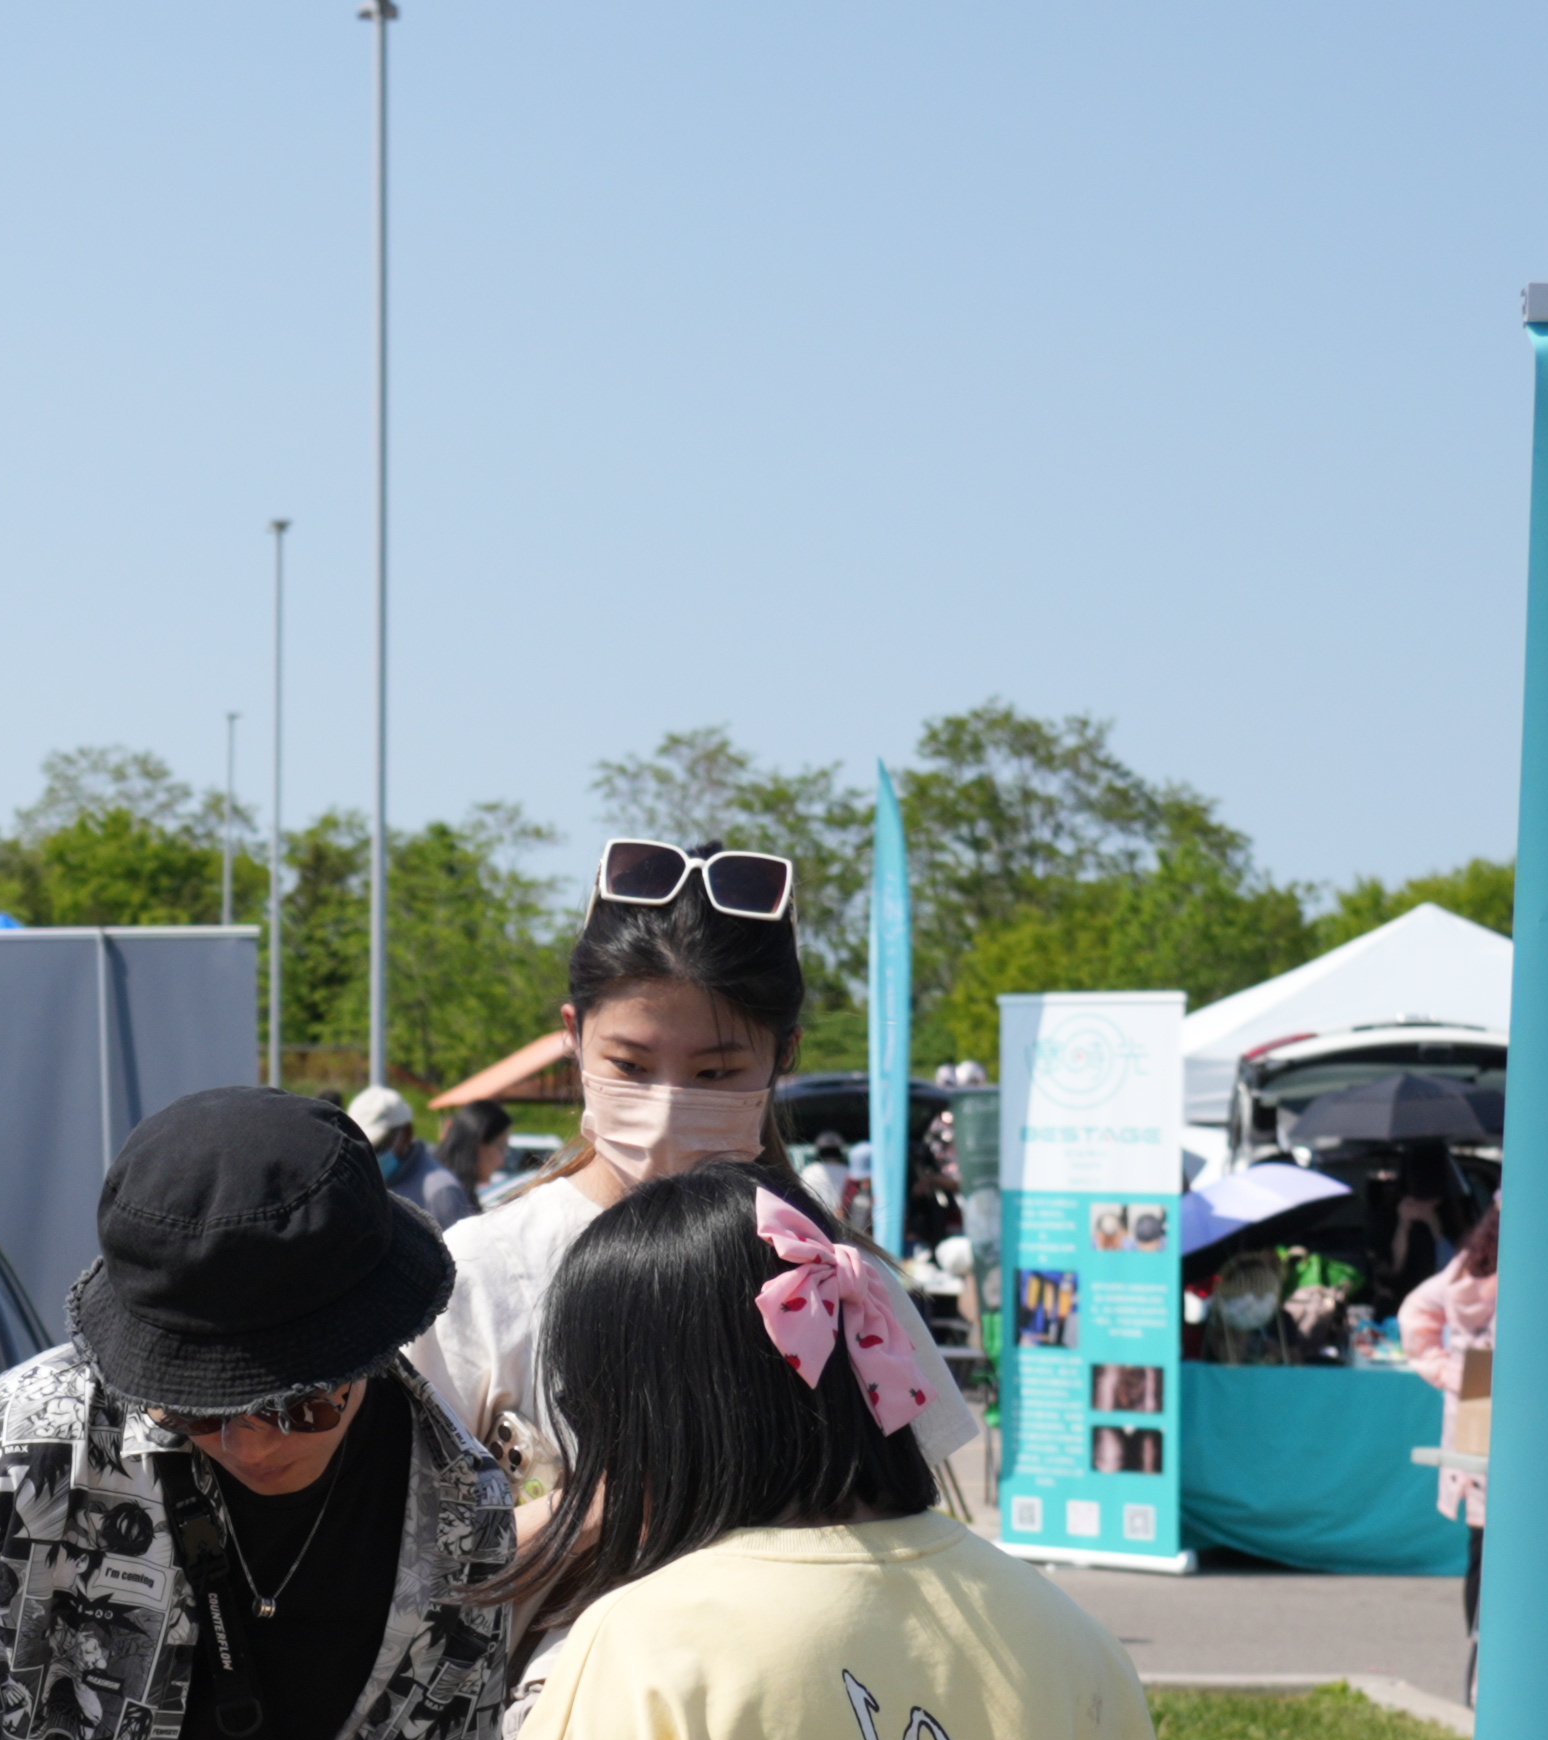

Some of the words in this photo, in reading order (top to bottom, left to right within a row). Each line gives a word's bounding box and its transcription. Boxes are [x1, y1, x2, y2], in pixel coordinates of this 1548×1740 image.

[4, 1443, 29, 1455] MAX
[104, 1567, 118, 1580] I'm
[120, 1570, 155, 1589] coming
[207, 1591, 235, 1672] COUNTERFLOW
